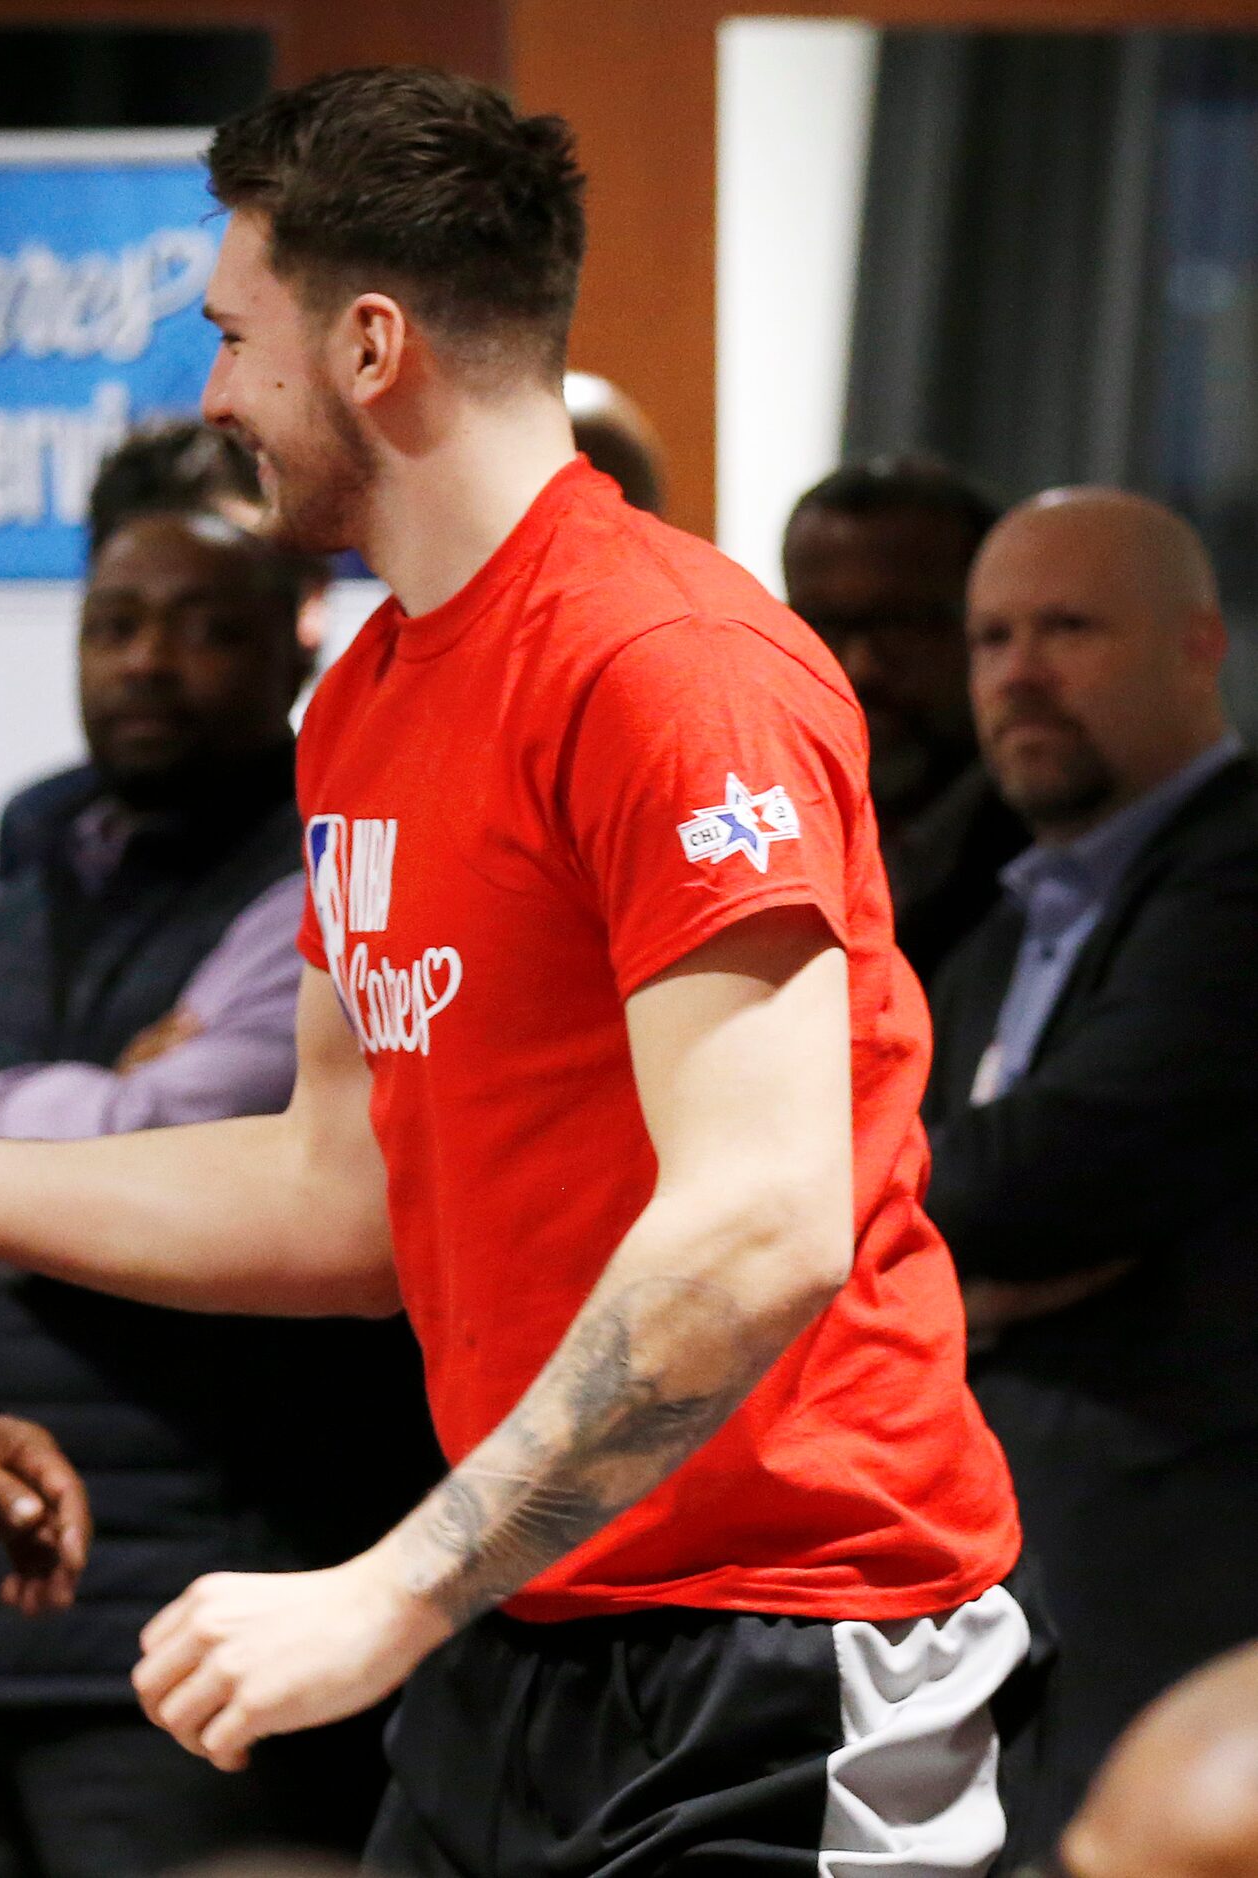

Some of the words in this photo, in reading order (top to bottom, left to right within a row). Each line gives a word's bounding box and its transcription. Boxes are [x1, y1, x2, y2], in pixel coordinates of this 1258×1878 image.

[348, 818, 398, 932] NBA
[691, 826, 721, 846] CHI
[349, 941, 462, 1056] Cares
